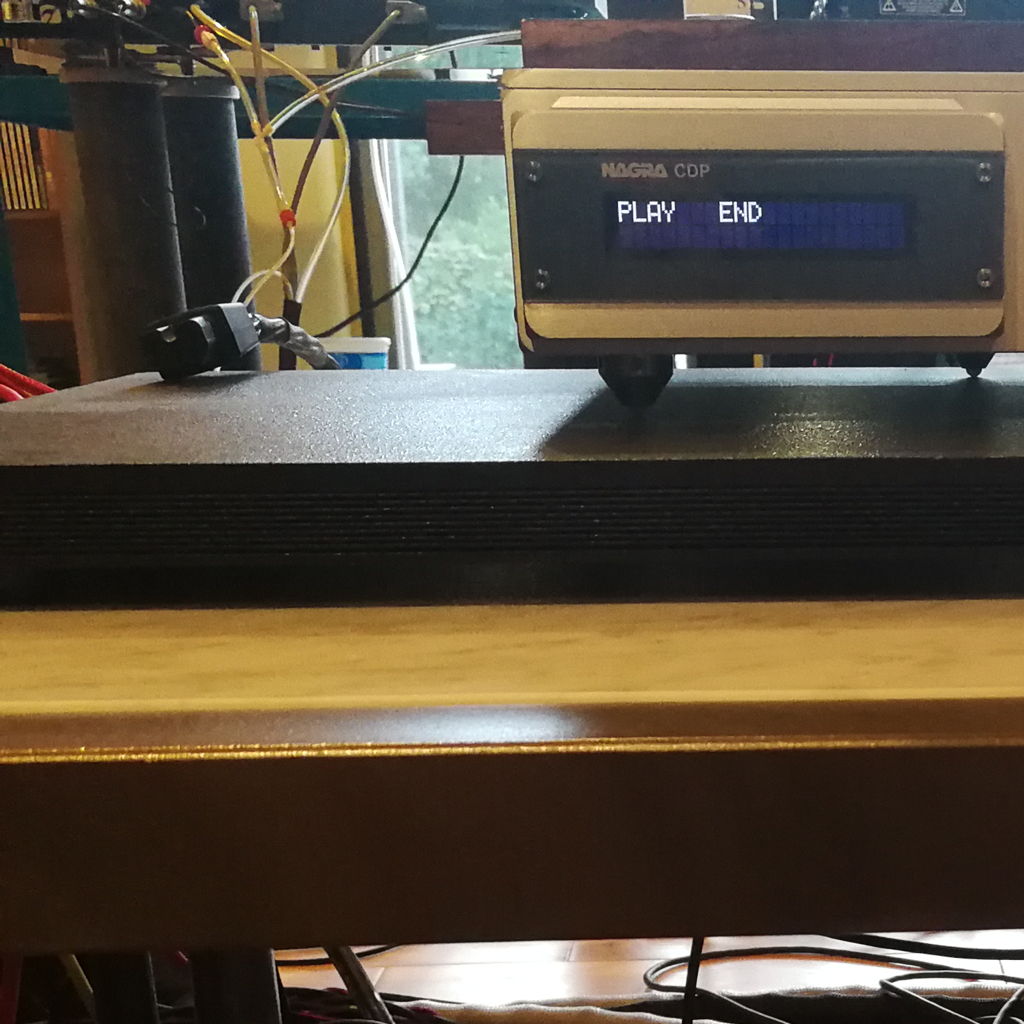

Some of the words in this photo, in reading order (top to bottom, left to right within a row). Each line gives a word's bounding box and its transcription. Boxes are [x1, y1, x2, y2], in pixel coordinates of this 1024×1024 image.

[601, 162, 668, 178] NAGRA
[674, 163, 711, 178] CDP
[617, 201, 676, 223] PLAY
[719, 201, 763, 223] END
